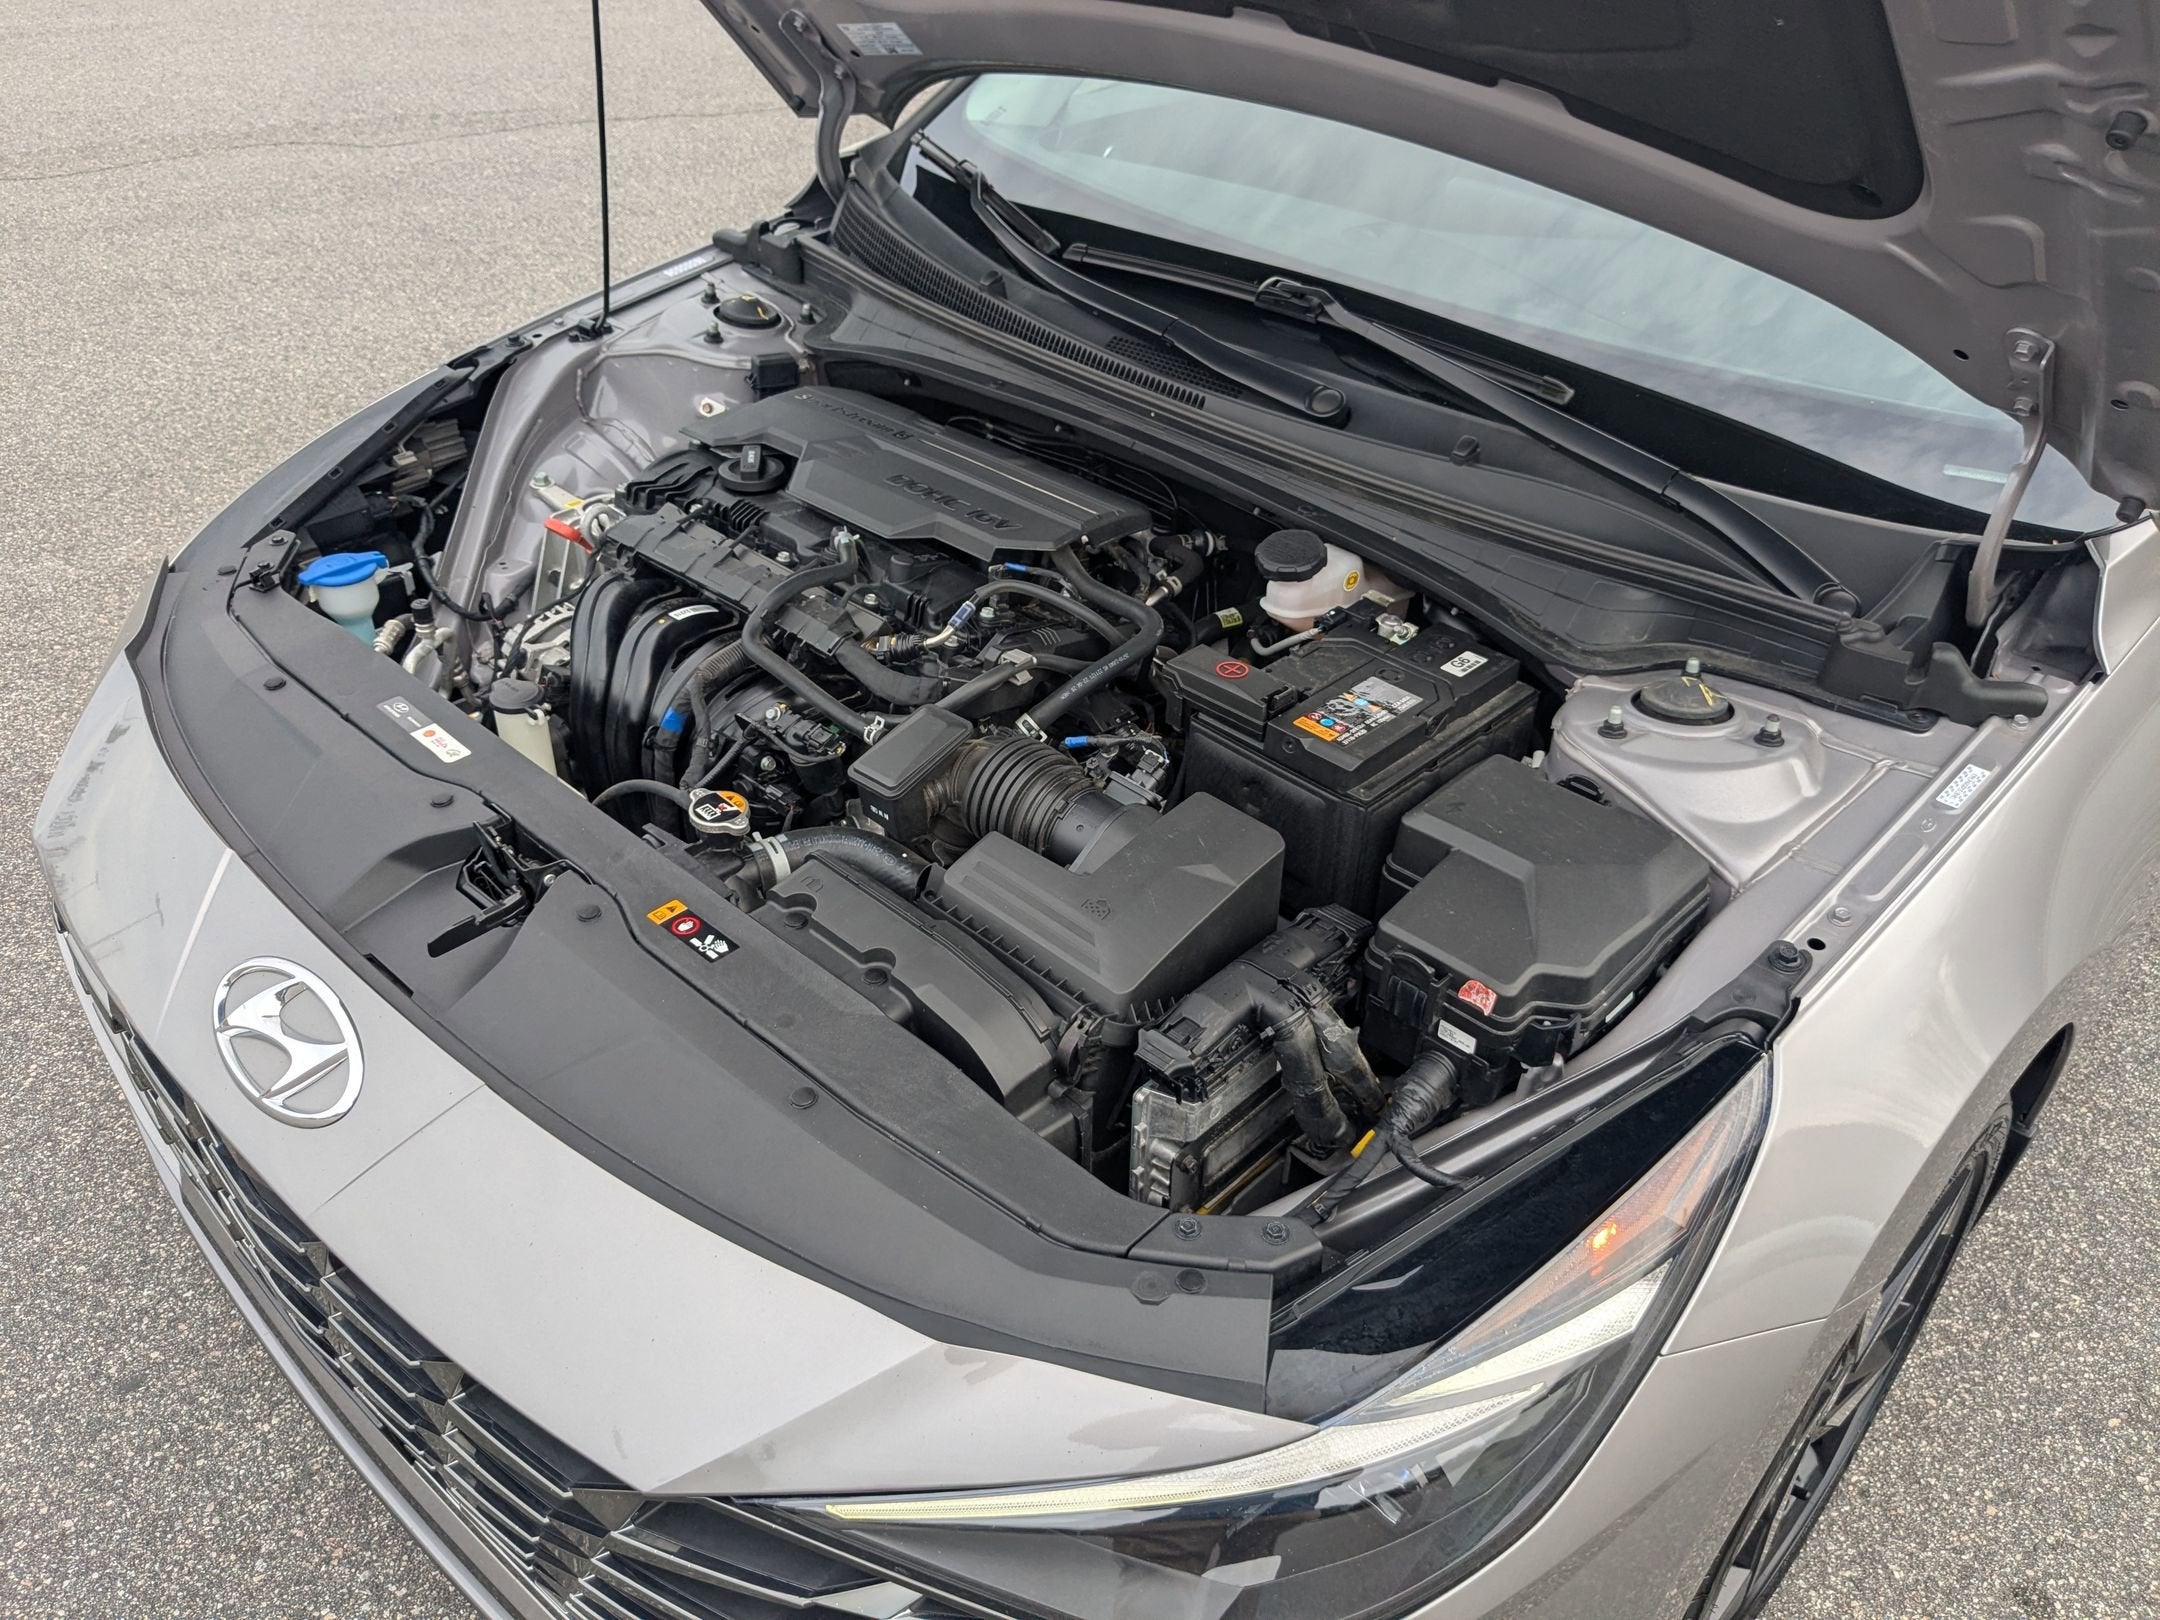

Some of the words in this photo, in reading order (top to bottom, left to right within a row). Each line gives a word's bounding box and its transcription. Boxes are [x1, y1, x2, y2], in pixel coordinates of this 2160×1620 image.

[883, 474, 972, 511] DOHC
[964, 507, 1024, 530] 16V
[1450, 656, 1471, 668] G6
